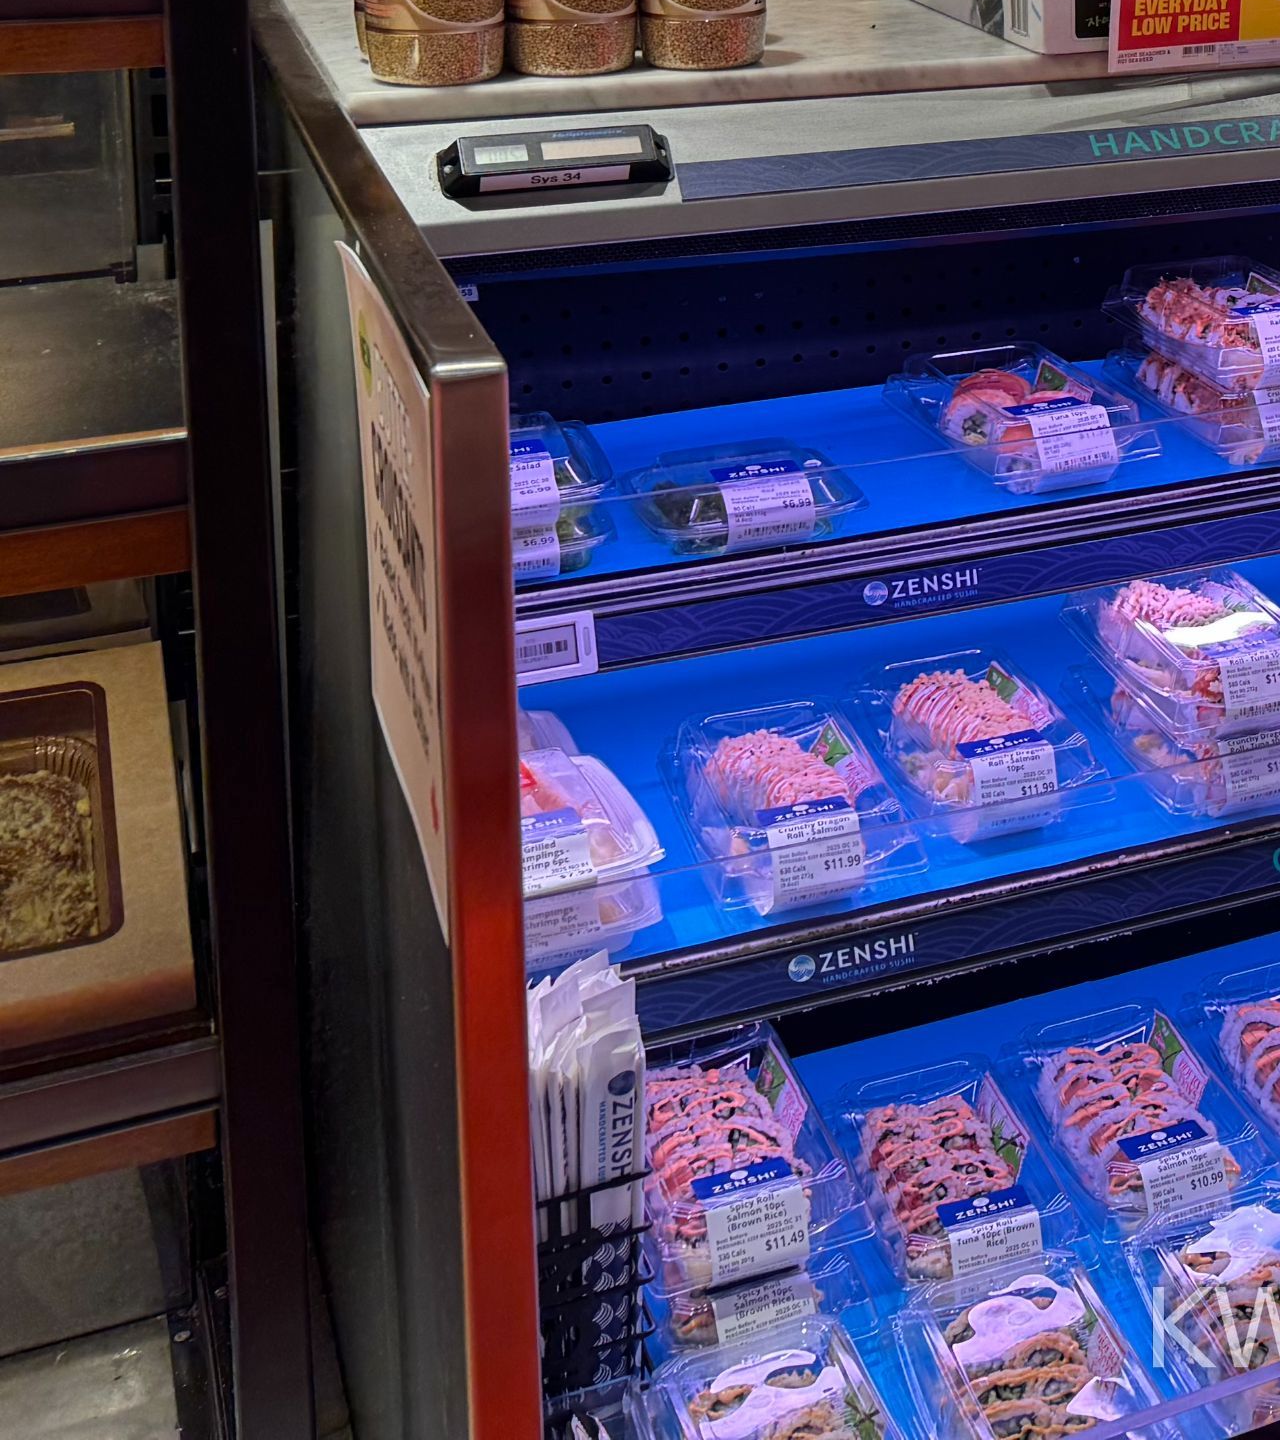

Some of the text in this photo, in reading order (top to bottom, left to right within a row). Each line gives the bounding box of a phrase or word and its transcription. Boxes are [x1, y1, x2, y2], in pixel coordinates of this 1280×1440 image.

[1131, 12, 1230, 37] LOW PRICE
[531, 172, 581, 185] Sys 34
[783, 497, 811, 509] $6.99
[891, 568, 979, 599] ZENSHI
[1021, 781, 1055, 797] $11.99
[775, 803, 834, 822] ZENSHI
[787, 824, 845, 841] Roll Salmon
[524, 839, 556, 854] Grilled
[824, 854, 861, 872] $11.99
[819, 933, 916, 974] ZENSHI
[611, 1091, 637, 1178] ZENSH
[712, 1169, 778, 1194] ZENSHI
[1190, 1172, 1224, 1191] $10.99
[726, 1199, 786, 1222] Salmon 10pc
[730, 1193, 774, 1213] Spicy Roll
[956, 1198, 1015, 1220] ZENSHI
[727, 1209, 787, 1234] (Brown Rice)
[765, 1229, 805, 1251] $11.49
